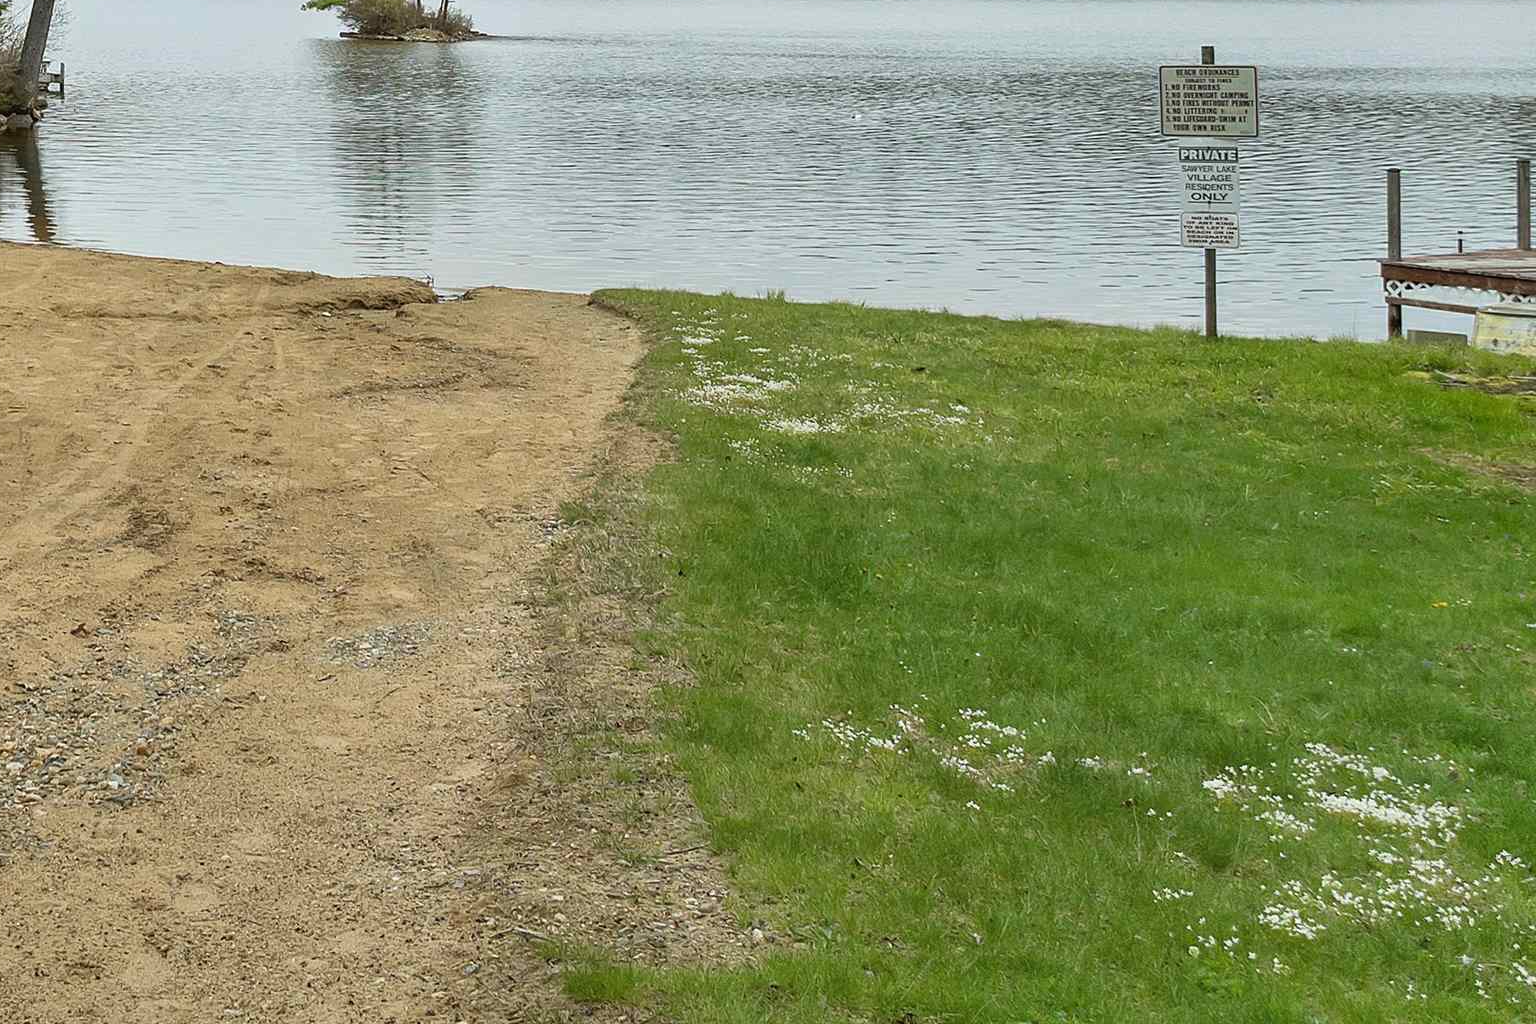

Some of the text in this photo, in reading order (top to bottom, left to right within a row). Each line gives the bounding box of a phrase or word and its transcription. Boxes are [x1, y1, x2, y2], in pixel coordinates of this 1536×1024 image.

[1180, 149, 1237, 160] PRIVATE
[1182, 165, 1237, 173] SAWYER LAKE
[1187, 174, 1232, 182] VILLAGE
[1185, 183, 1234, 191] RESIDENTS
[1191, 193, 1228, 201] ONLY
